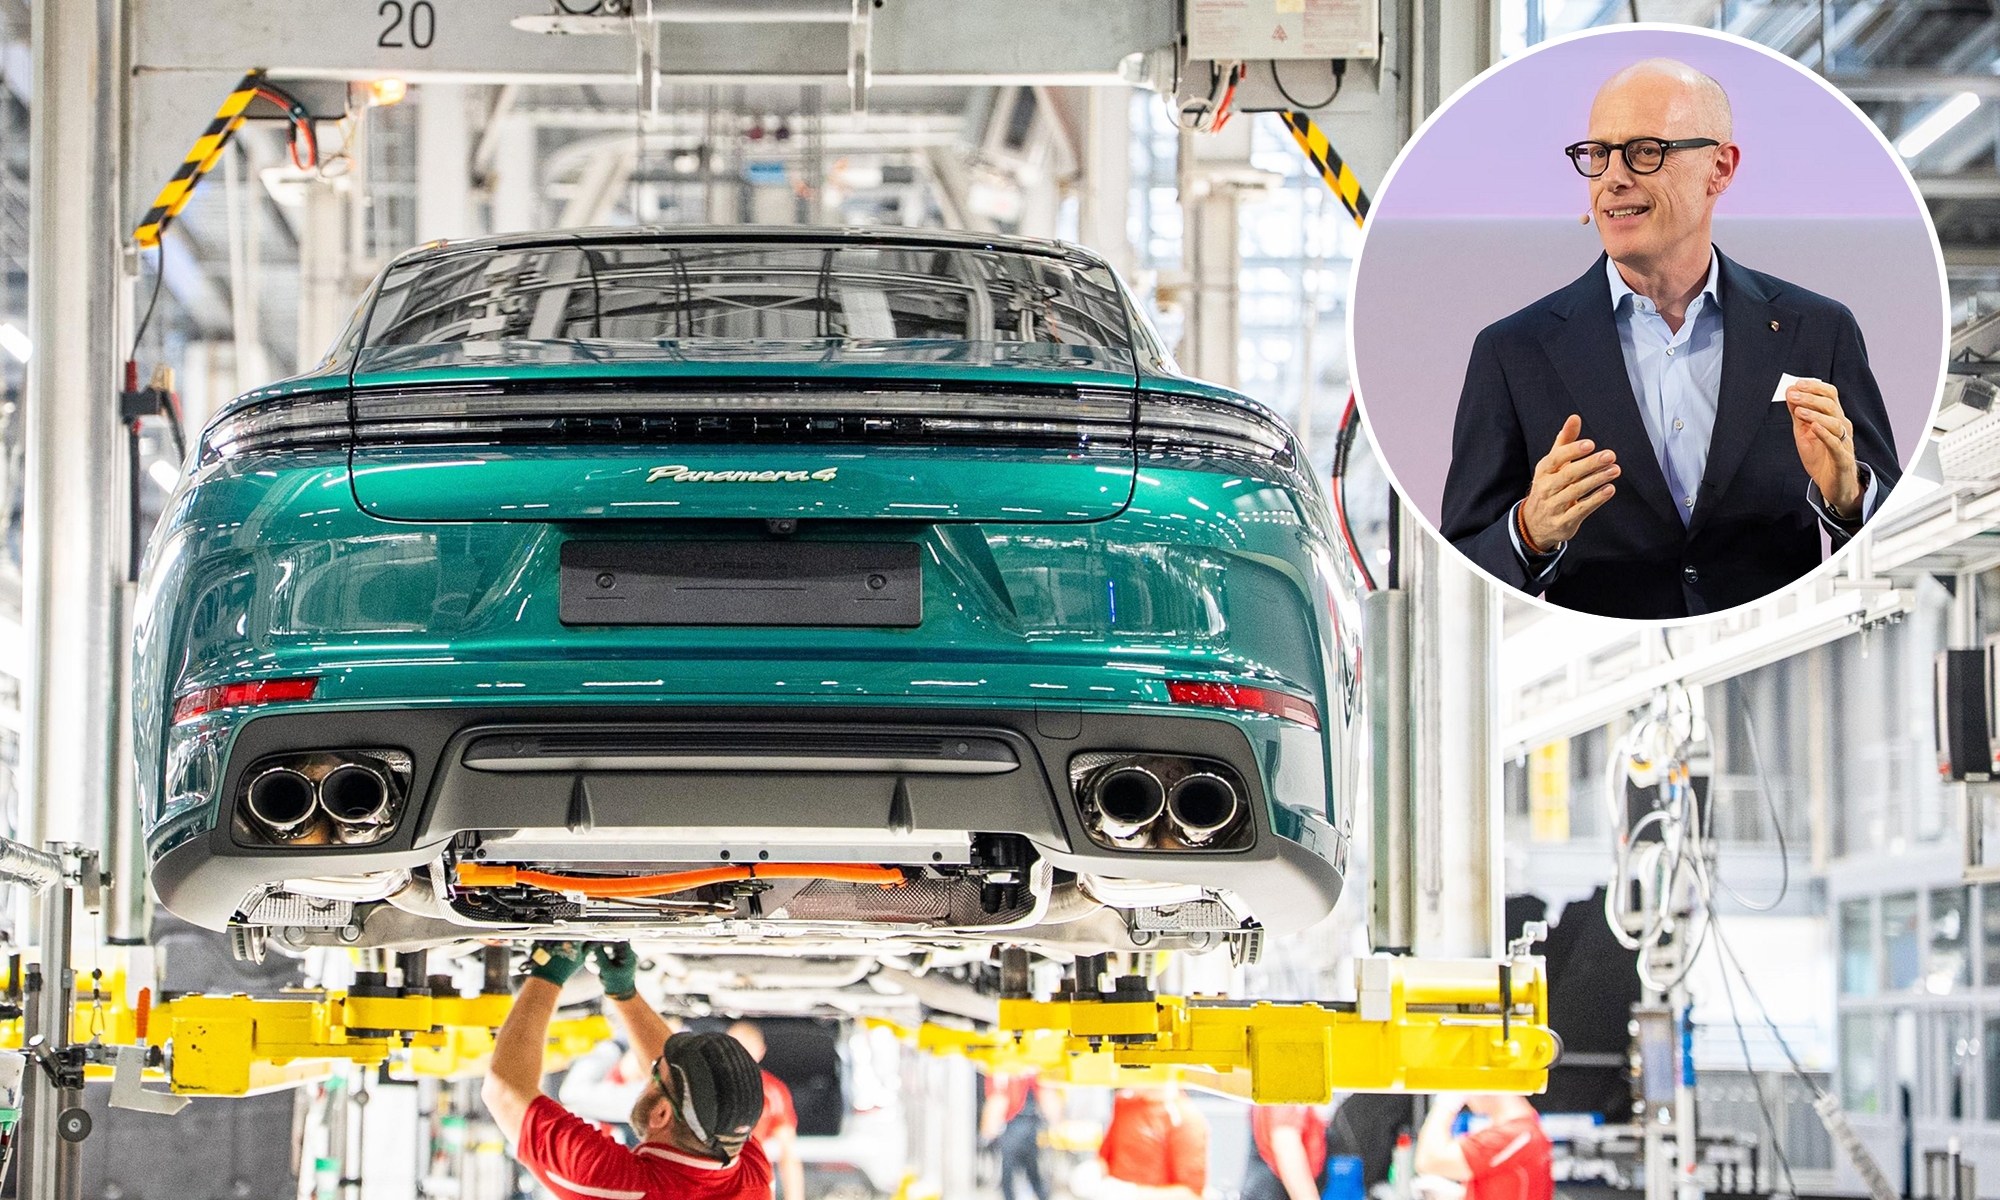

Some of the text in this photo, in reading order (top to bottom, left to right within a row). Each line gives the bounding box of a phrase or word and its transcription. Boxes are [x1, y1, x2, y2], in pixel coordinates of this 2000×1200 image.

[378, 1, 434, 48] 20
[646, 465, 838, 482] Panamera 4
